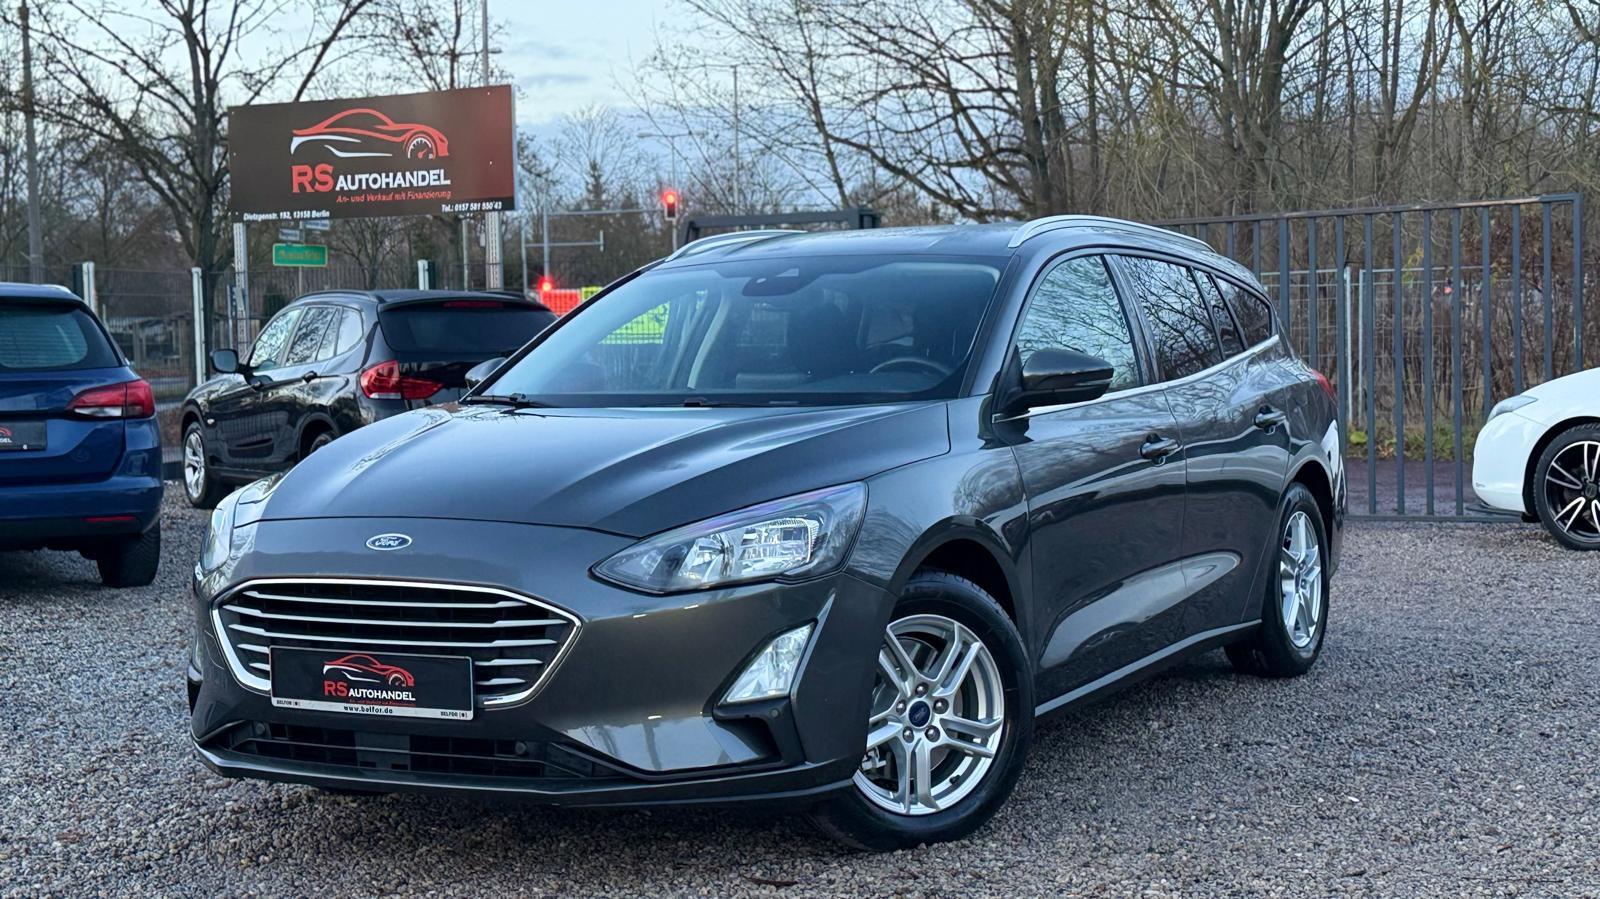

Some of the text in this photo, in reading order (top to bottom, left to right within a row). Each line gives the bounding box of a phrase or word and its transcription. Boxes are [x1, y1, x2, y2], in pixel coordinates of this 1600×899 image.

[291, 163, 451, 193] RS AUTOHANDEL
[311, 209, 330, 218] Berlin
[374, 536, 402, 547] Ford
[324, 680, 416, 701] RS AUTOHANDEL
